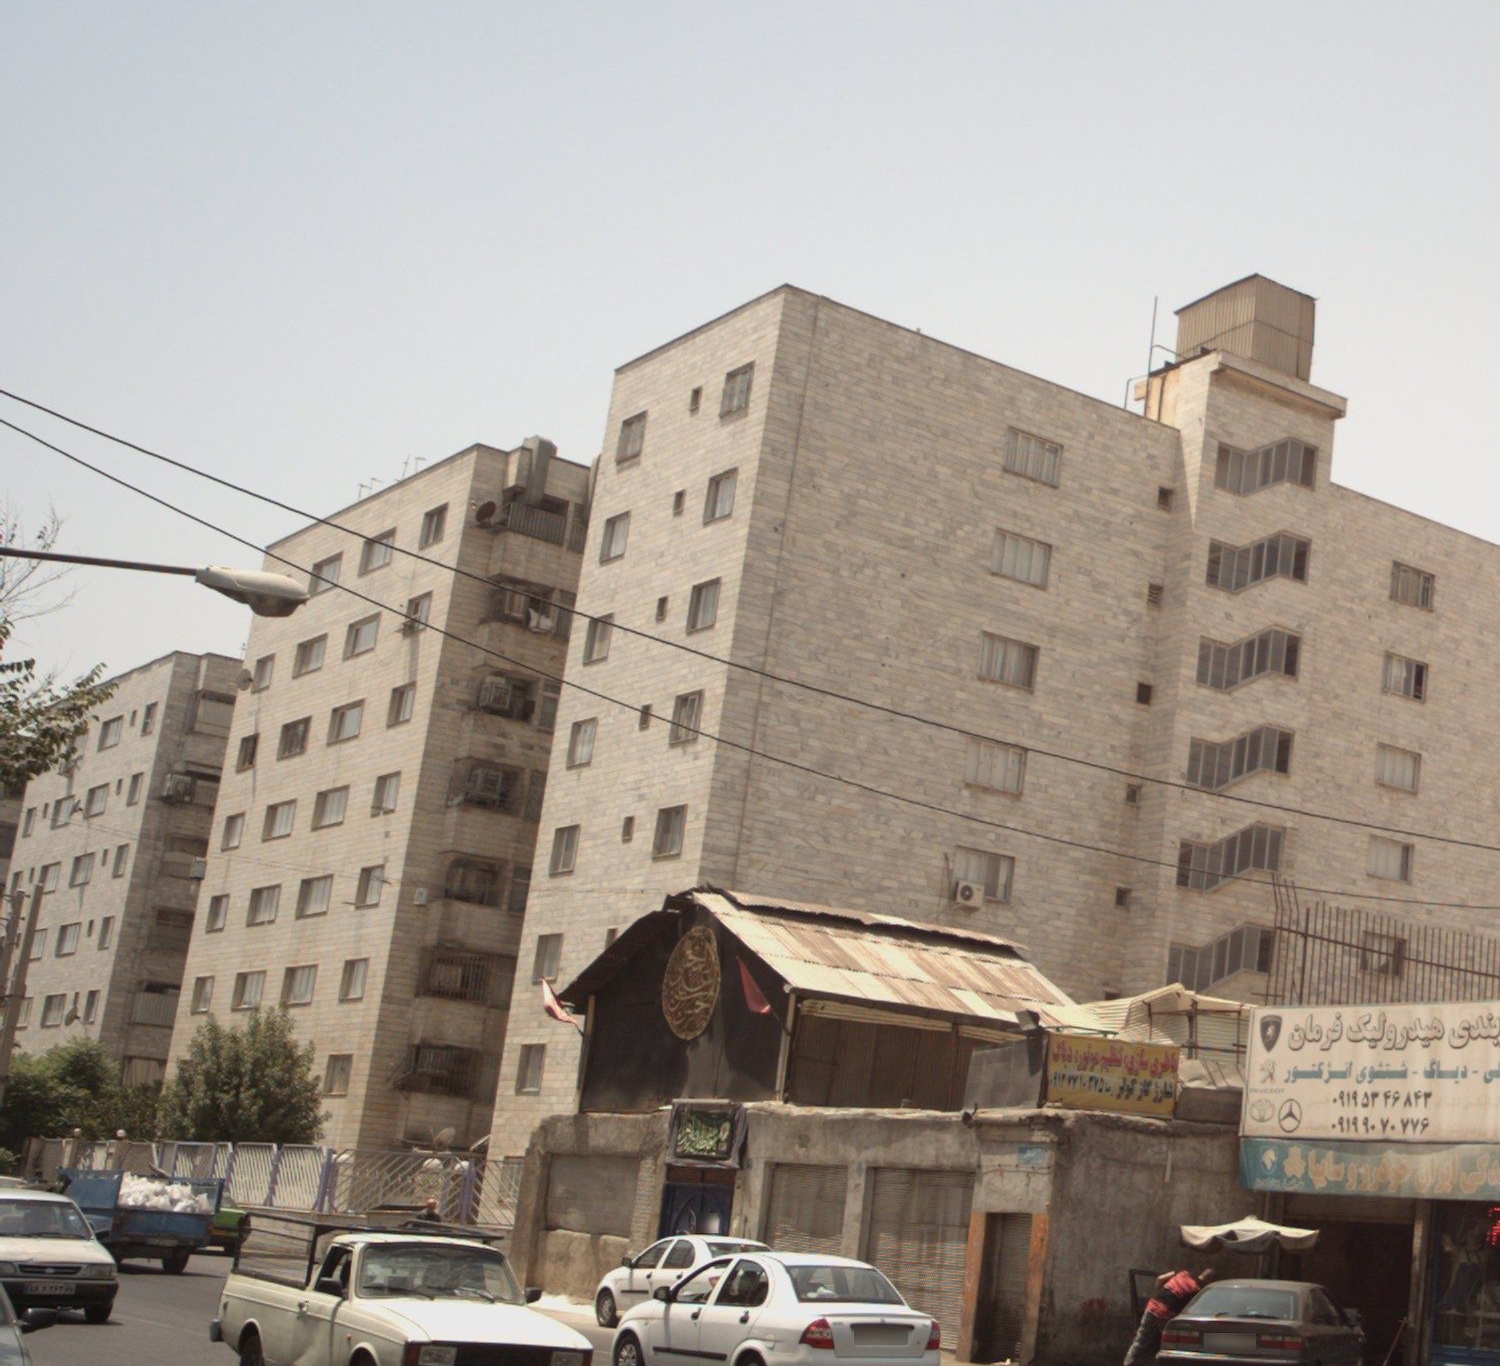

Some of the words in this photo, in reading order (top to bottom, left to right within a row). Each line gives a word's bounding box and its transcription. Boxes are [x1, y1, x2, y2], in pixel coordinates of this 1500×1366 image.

[1287, 1012, 1344, 1052] فرمان
[1346, 1011, 1446, 1052] هیدرولیک
[1331, 1089, 1358, 1109] ۰۹۱۹
[1361, 1091, 1379, 1108] ۵۳
[1383, 1089, 1400, 1108] ۴۶
[1403, 1089, 1433, 1109] ۸۴۳
[1331, 1115, 1358, 1134] ۰۹۱۹
[1362, 1116, 1376, 1134] ۹۰
[1380, 1118, 1396, 1134] ۷۰
[1400, 1117, 1430, 1135] ۷۷۶
